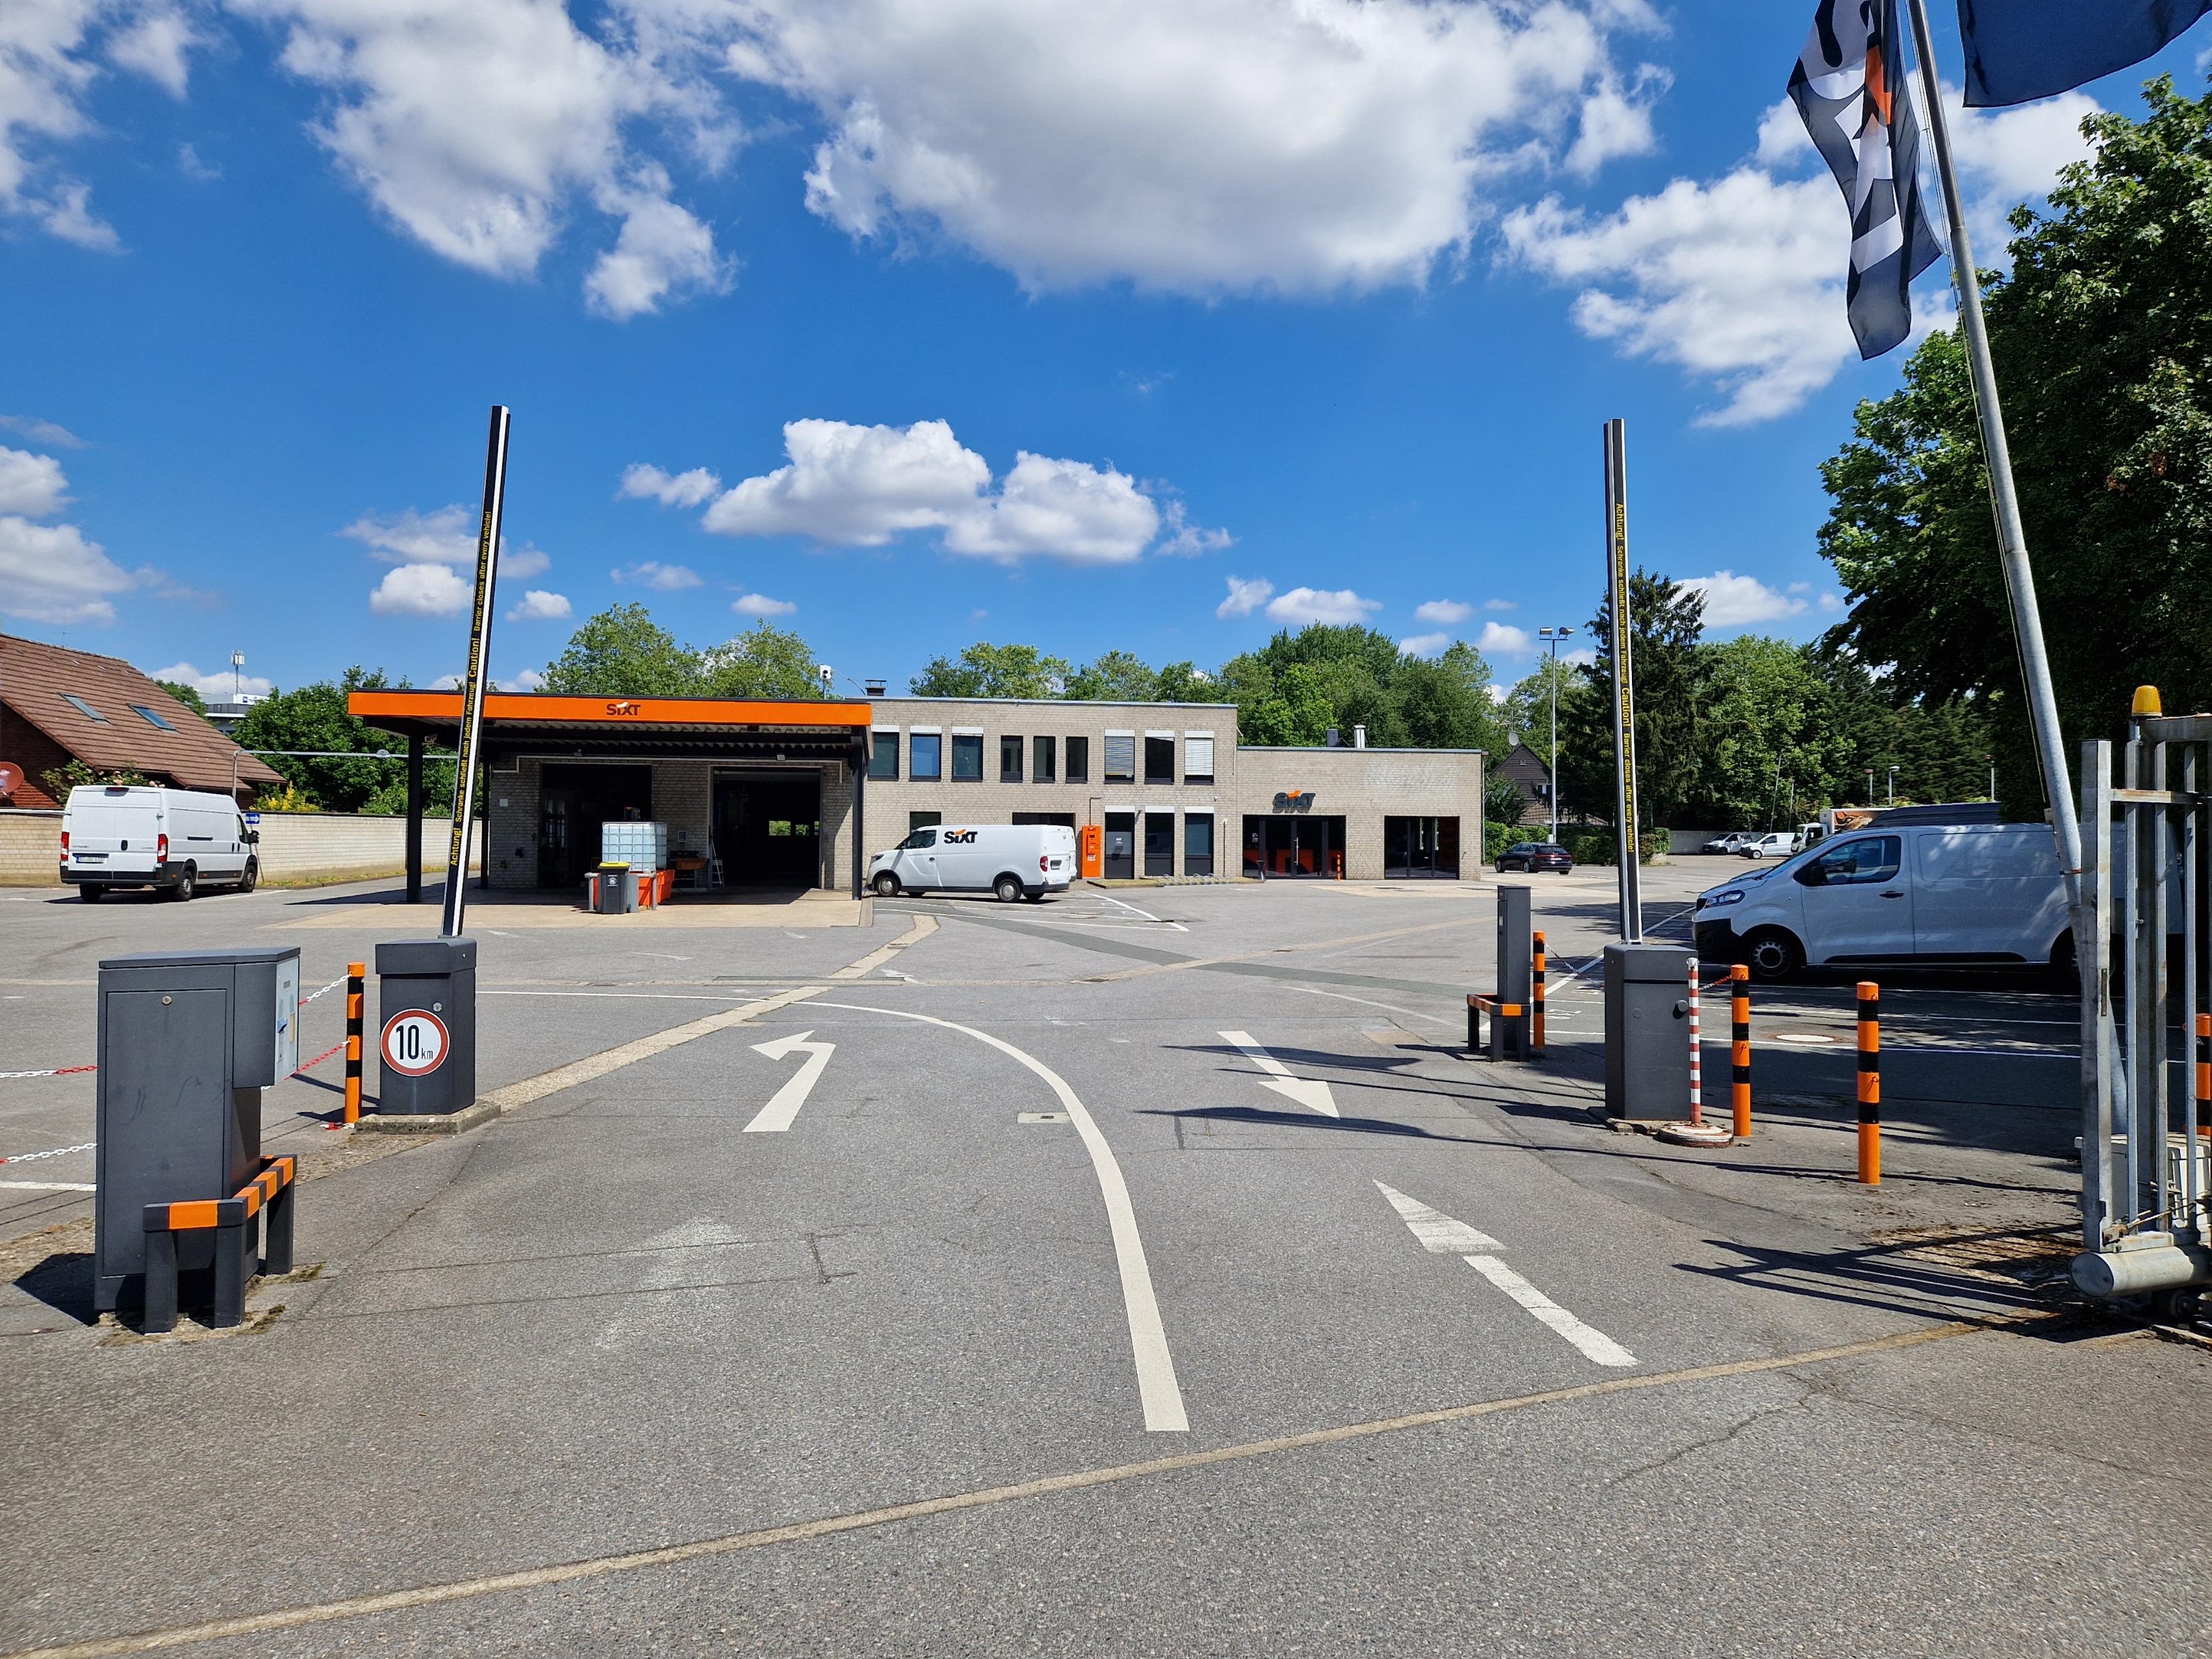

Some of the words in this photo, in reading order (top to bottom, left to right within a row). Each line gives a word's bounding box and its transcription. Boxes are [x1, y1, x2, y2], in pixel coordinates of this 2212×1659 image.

[474, 607, 482, 631] Barrier
[1615, 504, 1624, 540] Achtung!
[1622, 688, 1631, 726] Caution!
[468, 638, 480, 677] Caution!
[466, 682, 476, 714] Fahrzeug!
[607, 702, 641, 715] SIXT
[456, 790, 464, 822] Schranke
[450, 828, 462, 865] Achtung!
[944, 829, 978, 843] SIXT
[396, 1024, 419, 1060] 10
[422, 1047, 433, 1060] km
